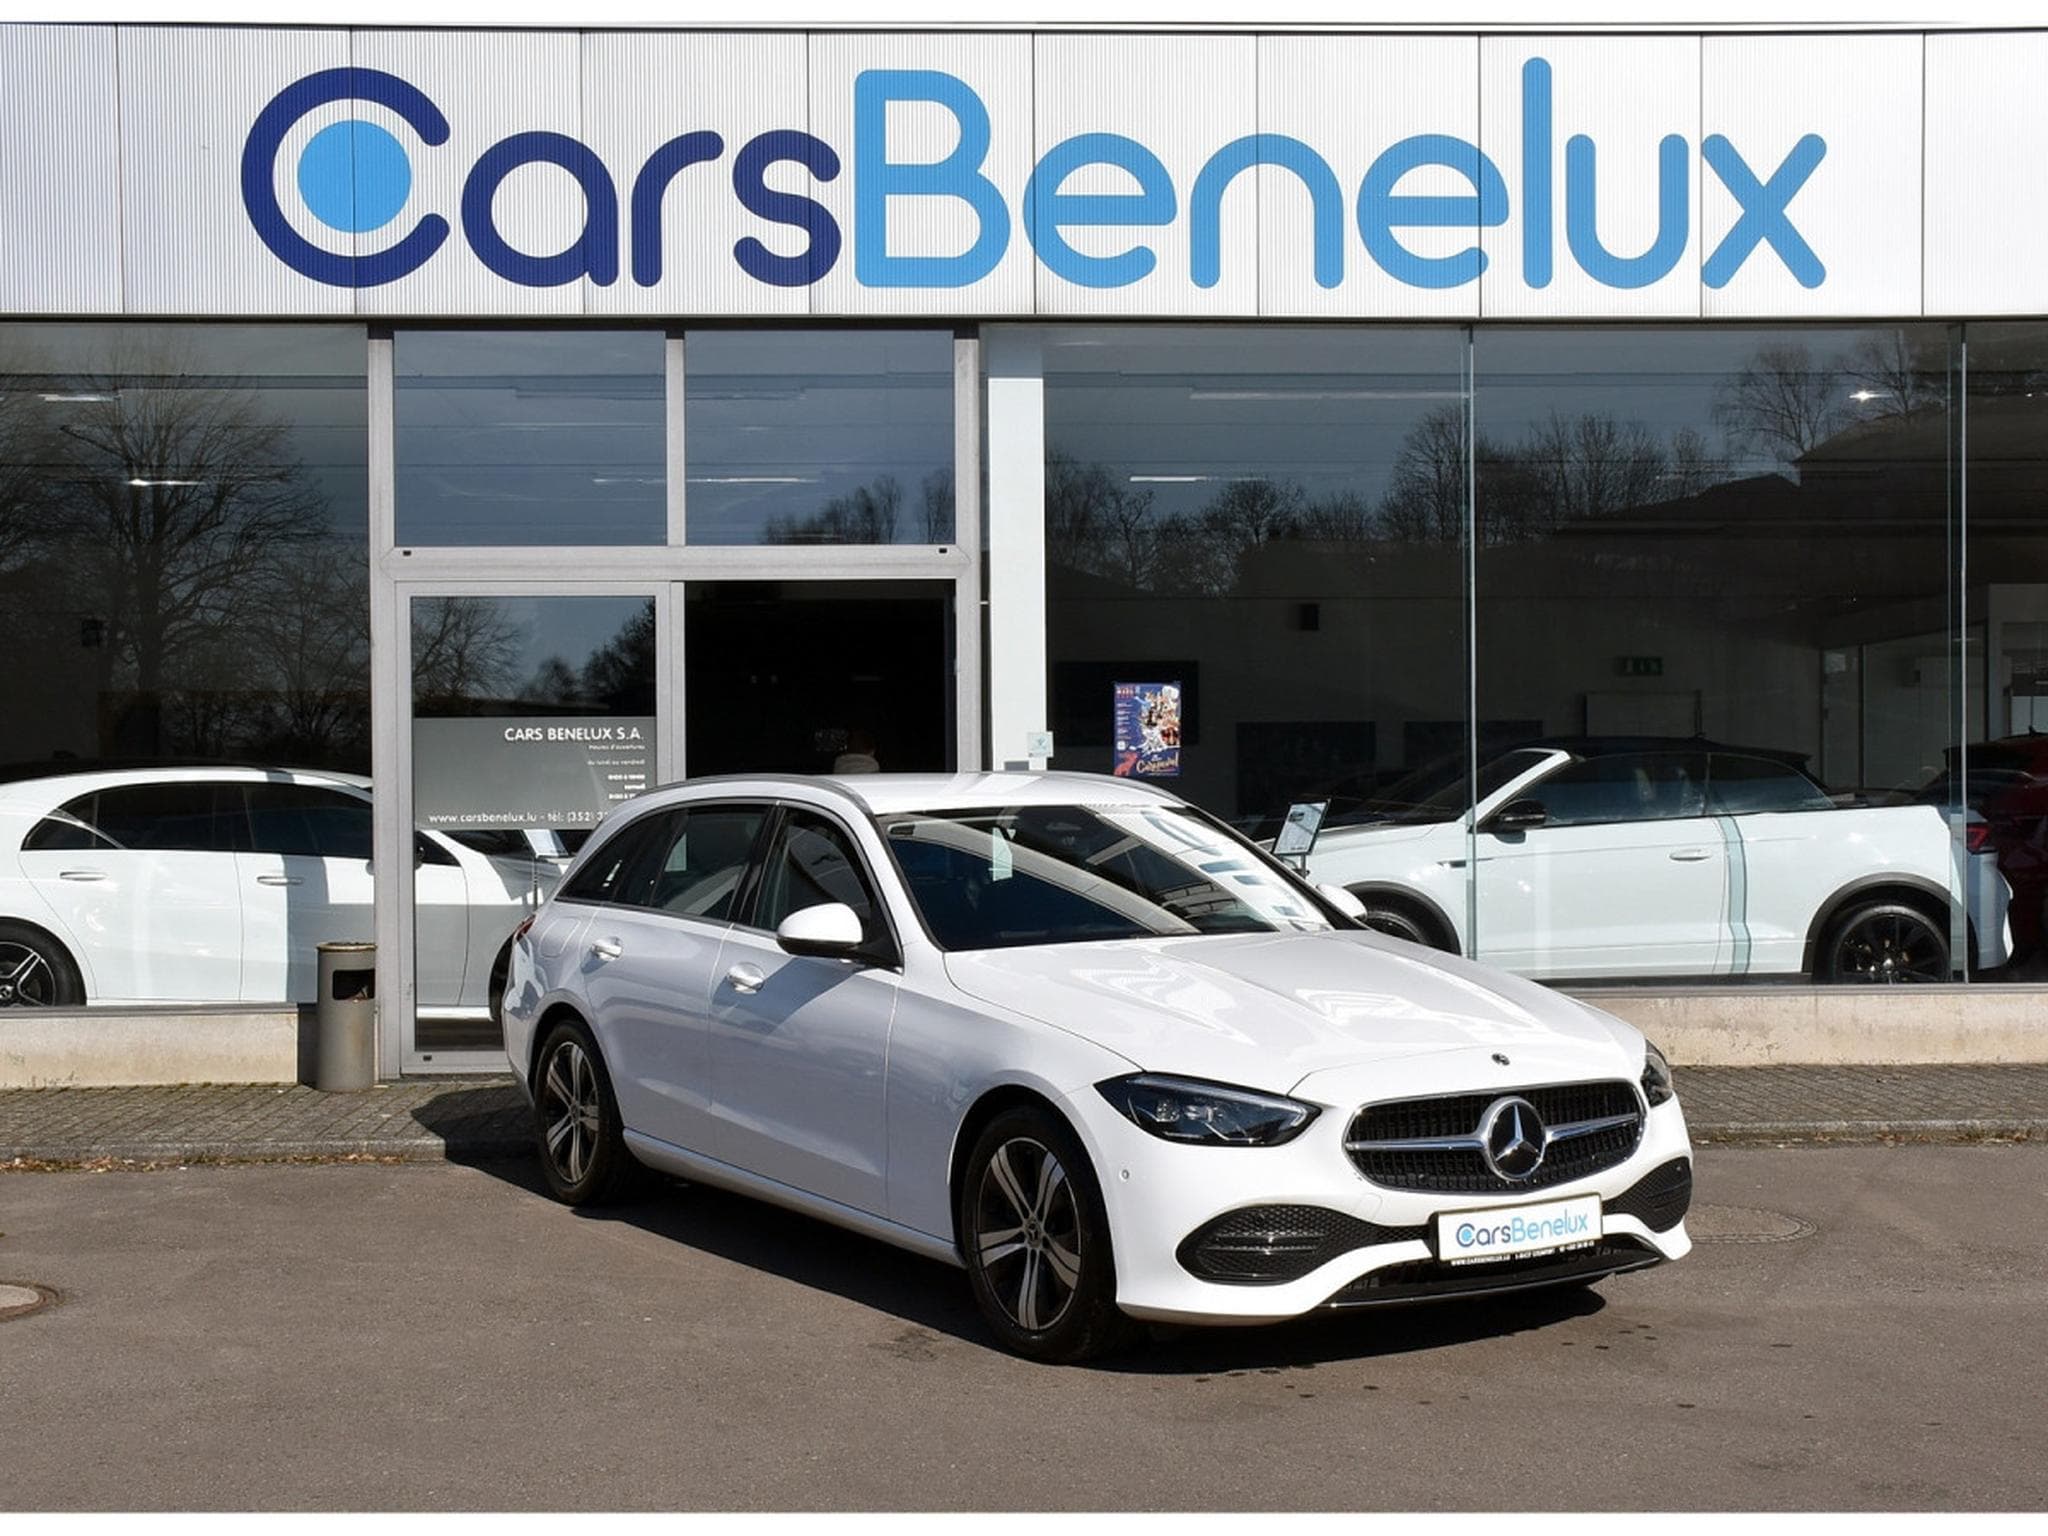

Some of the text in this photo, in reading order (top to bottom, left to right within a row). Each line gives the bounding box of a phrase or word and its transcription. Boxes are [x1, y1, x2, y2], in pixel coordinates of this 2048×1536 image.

[504, 727, 644, 741] CARS BENELUX S.A.
[428, 812, 537, 824] www.carsbenelux.lu
[1456, 1209, 1588, 1248] CarsBenelux
